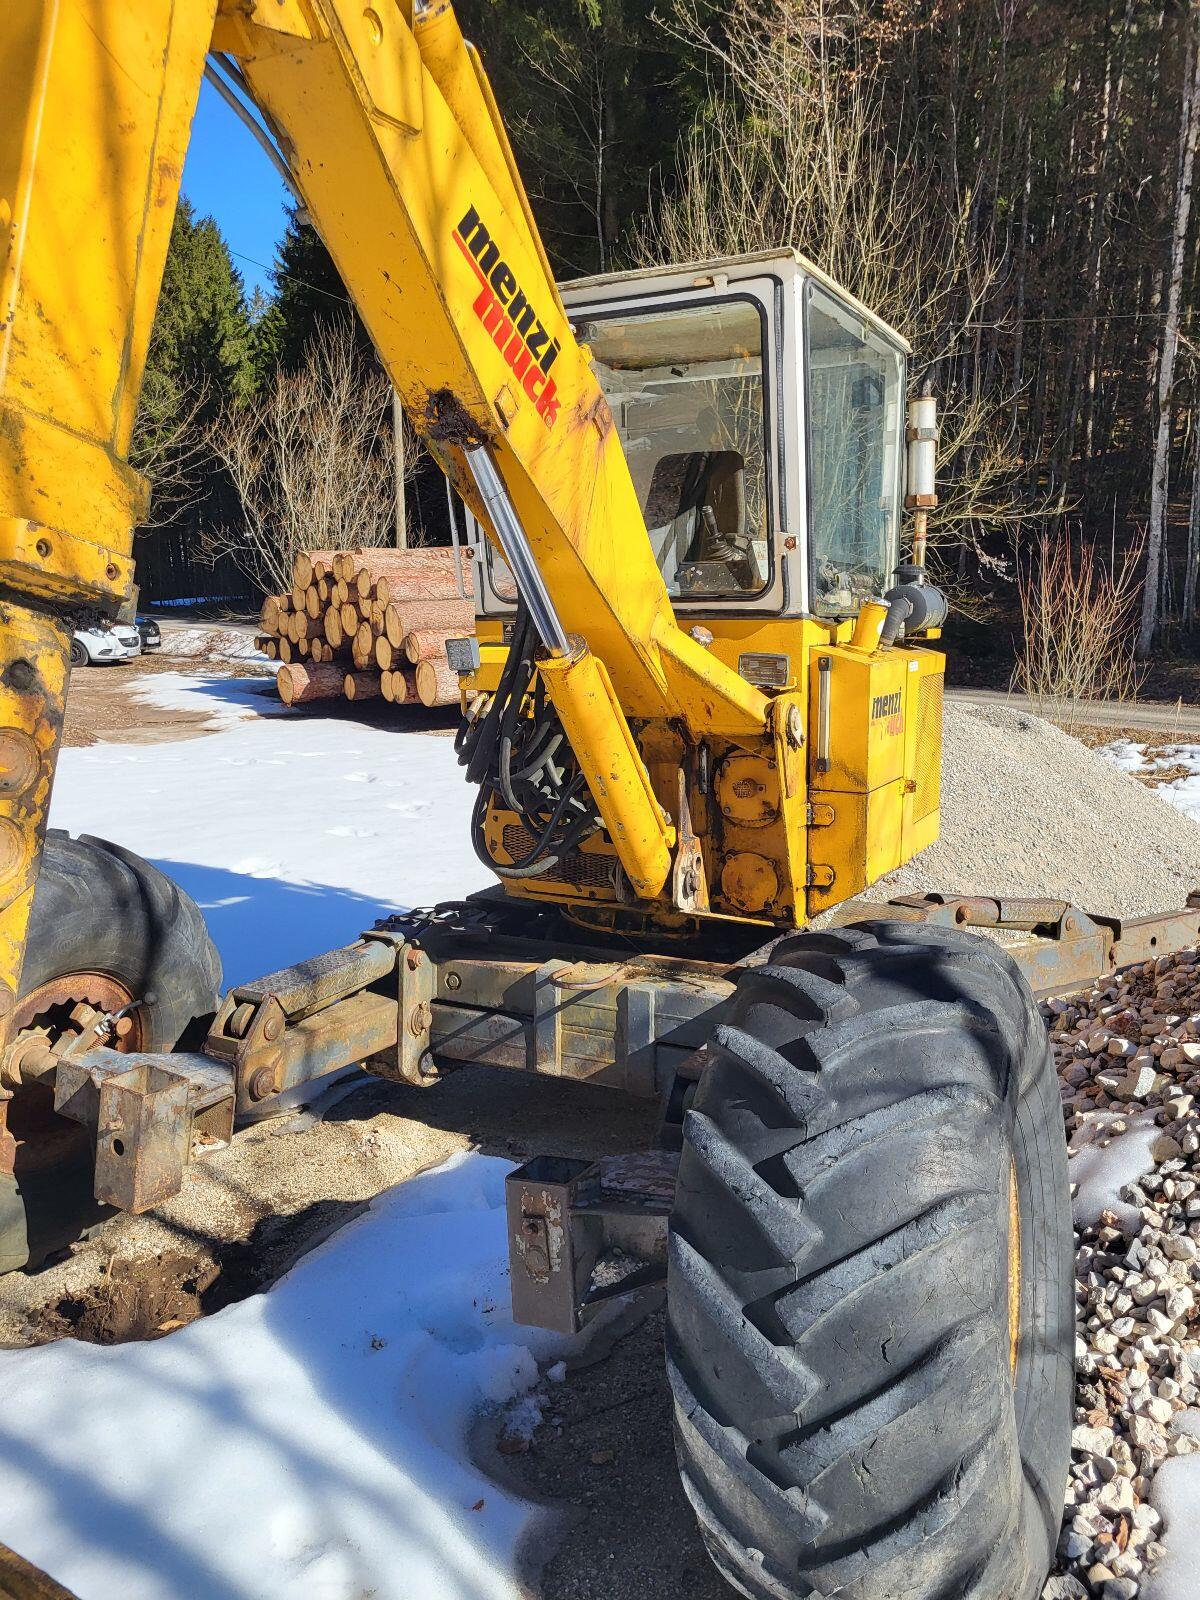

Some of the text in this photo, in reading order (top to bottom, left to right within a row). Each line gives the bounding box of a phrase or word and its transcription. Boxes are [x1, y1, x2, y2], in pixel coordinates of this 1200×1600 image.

[457, 204, 561, 378] menzi
[472, 286, 561, 432] muck
[871, 686, 902, 720] menzi
